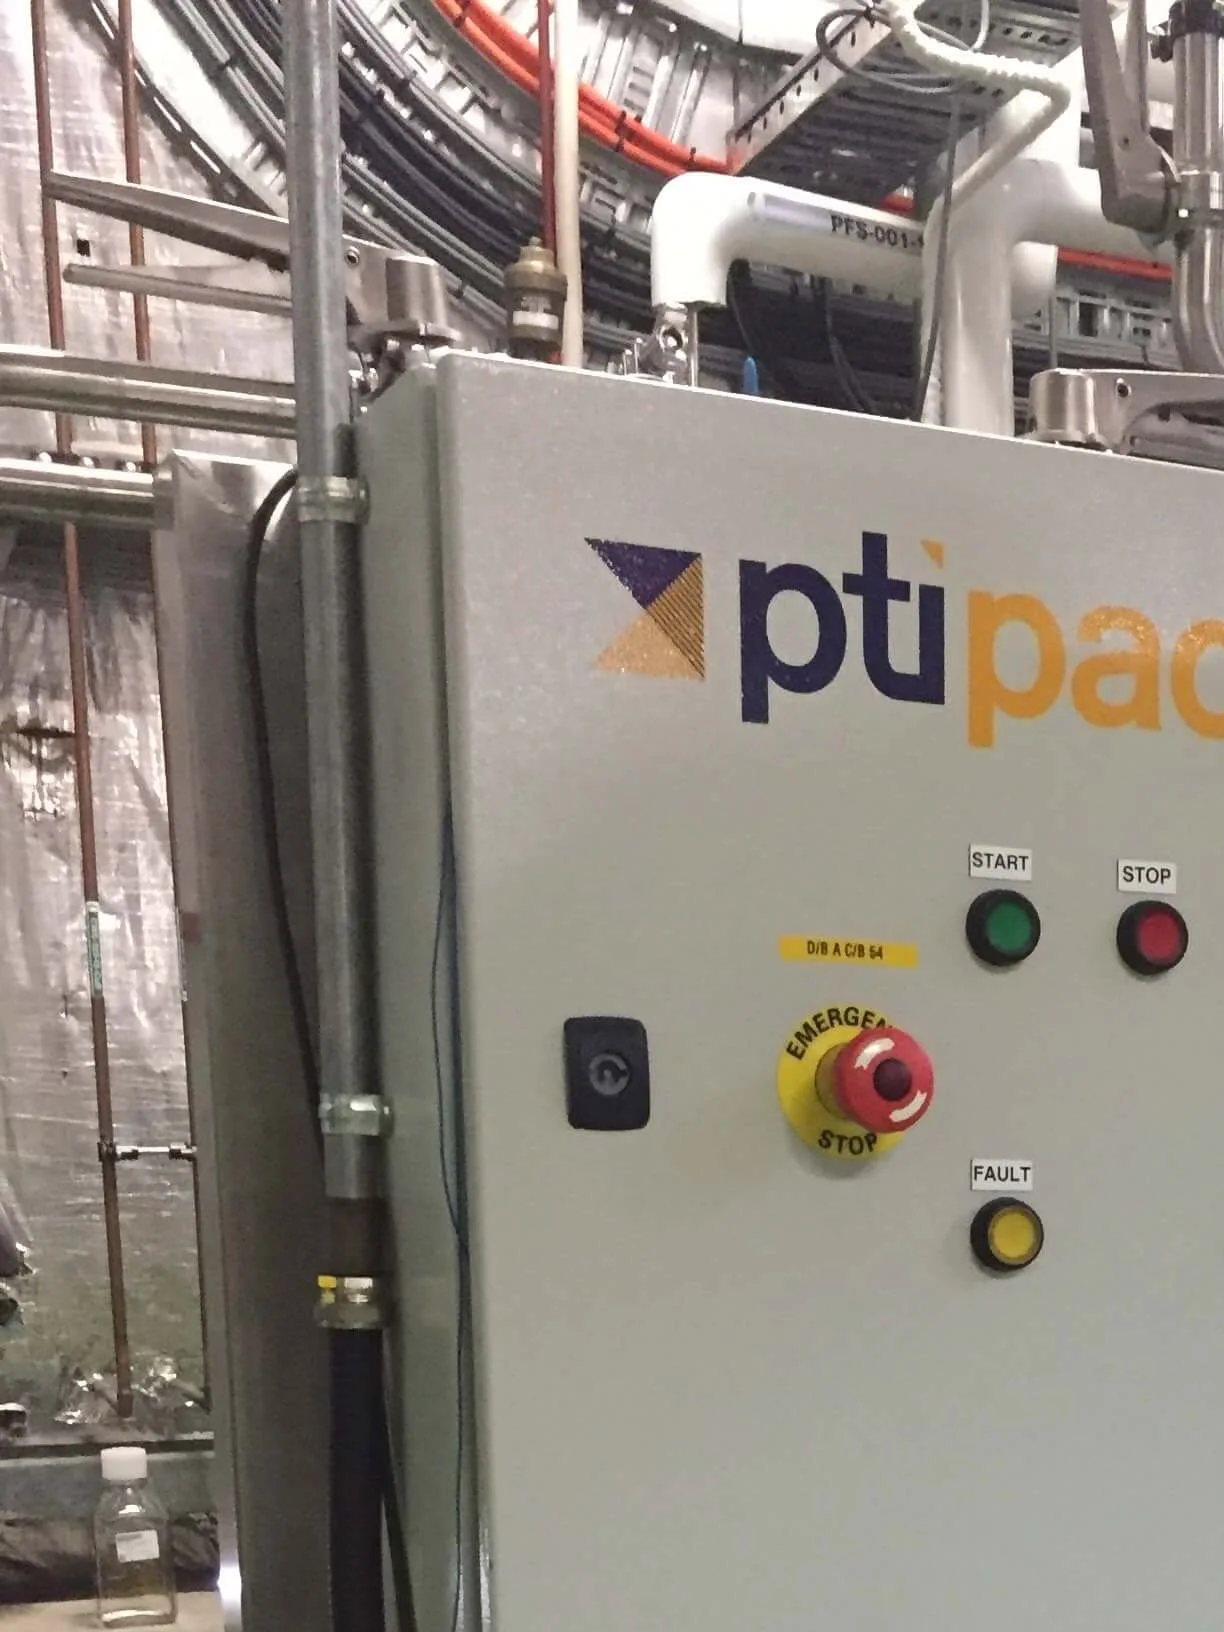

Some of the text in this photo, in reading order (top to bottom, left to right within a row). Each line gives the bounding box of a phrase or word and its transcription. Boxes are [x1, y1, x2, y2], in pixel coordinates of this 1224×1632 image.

[972, 852, 1029, 871] START
[1123, 866, 1171, 884] STOP
[833, 942, 841, 957] A
[818, 1129, 878, 1156] STOP
[973, 1165, 1031, 1183] FAULT
